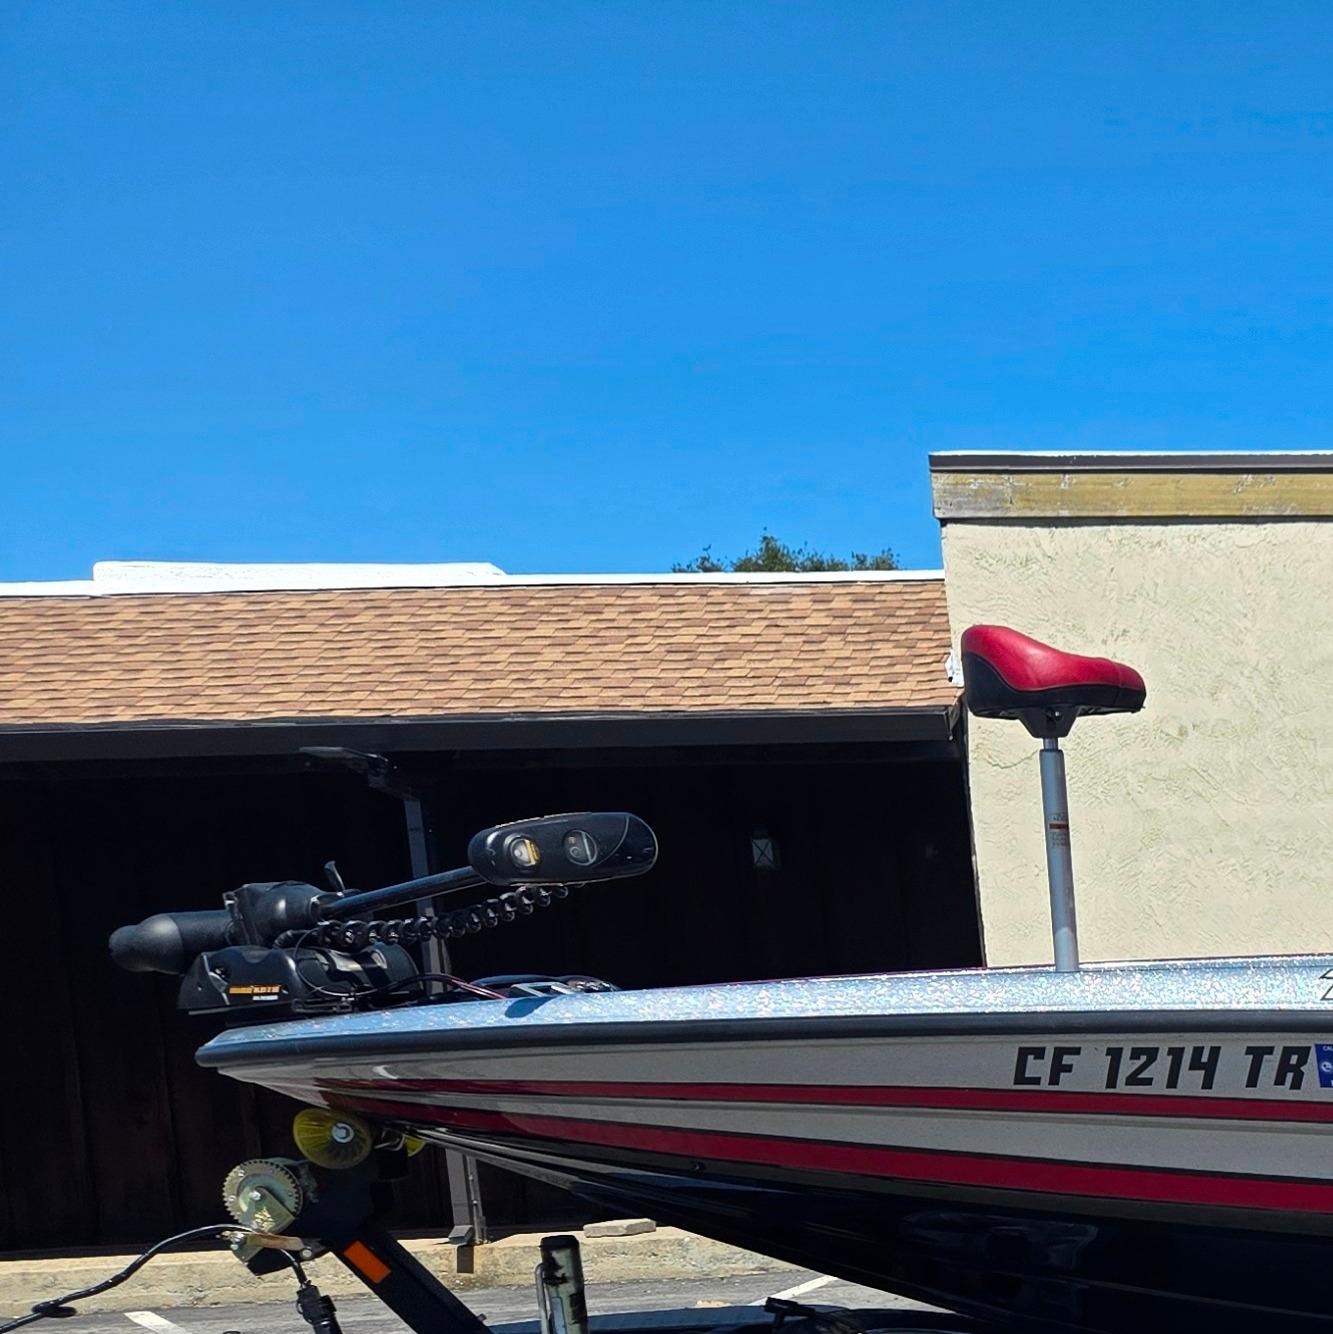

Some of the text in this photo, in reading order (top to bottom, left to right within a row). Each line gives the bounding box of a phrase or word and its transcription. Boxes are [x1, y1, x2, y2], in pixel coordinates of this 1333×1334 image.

[1013, 1046, 1312, 1091] CF 1214 TR
